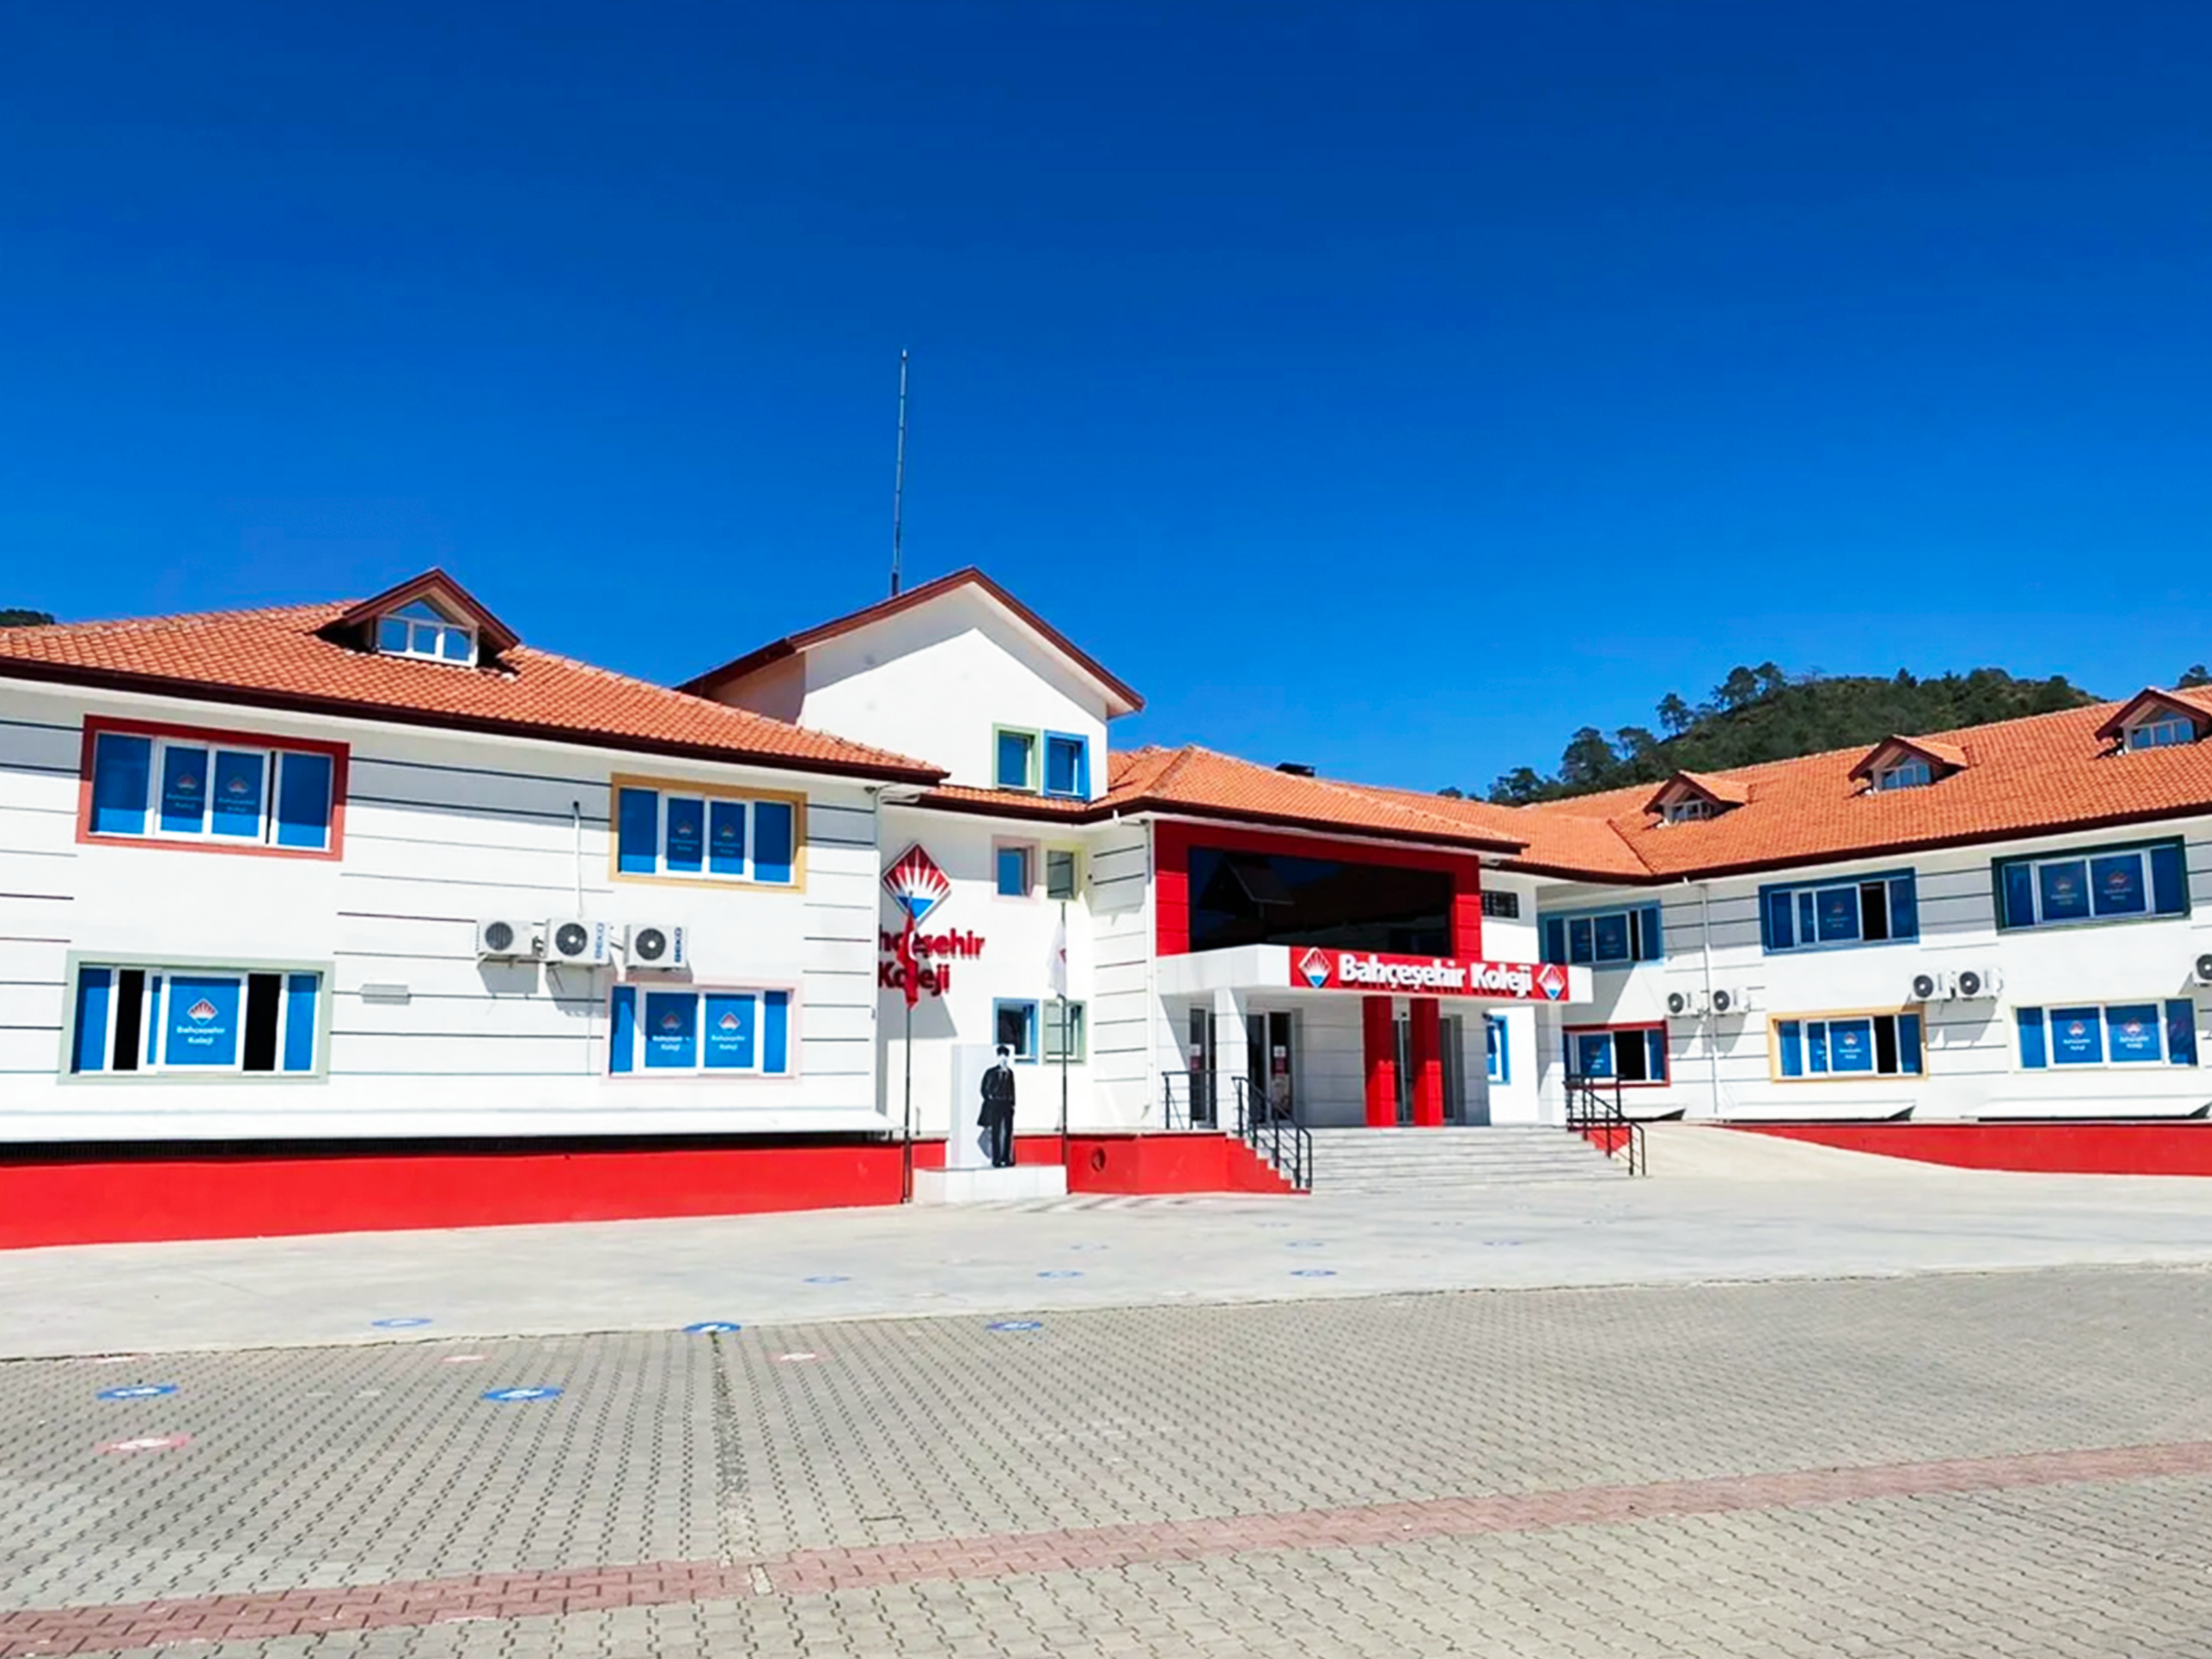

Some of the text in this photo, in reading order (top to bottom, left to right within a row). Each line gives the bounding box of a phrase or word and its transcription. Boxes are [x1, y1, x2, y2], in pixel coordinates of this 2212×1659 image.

[878, 961, 950, 997] Koeji
[1338, 953, 1534, 998] Bahçeşehir Koleji
